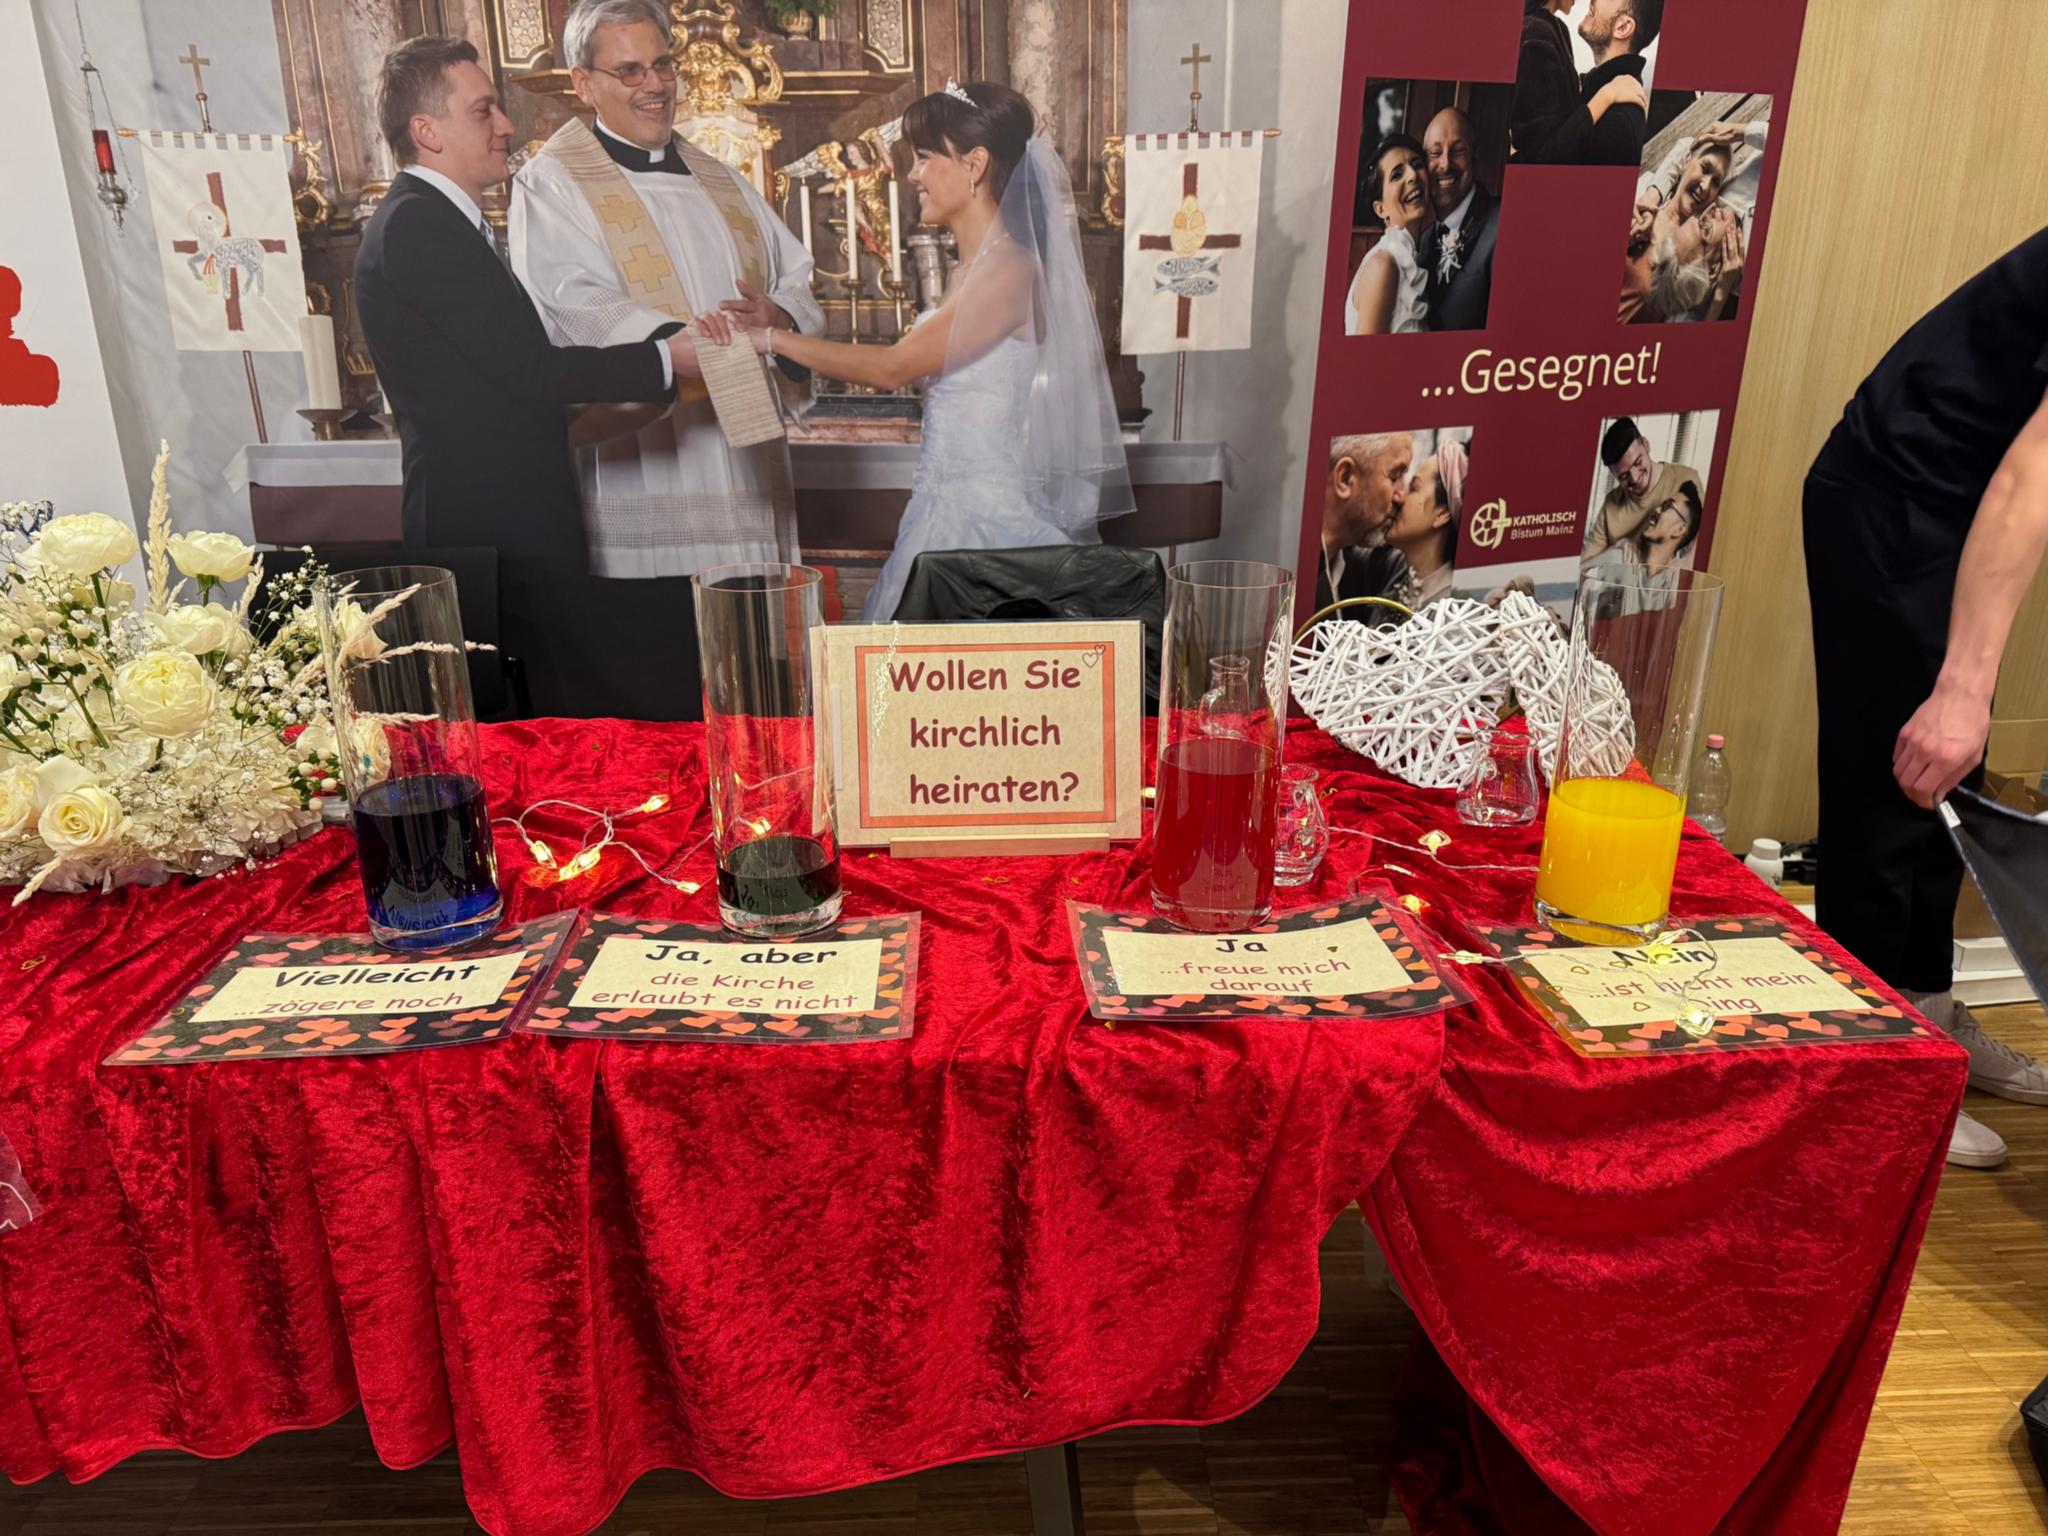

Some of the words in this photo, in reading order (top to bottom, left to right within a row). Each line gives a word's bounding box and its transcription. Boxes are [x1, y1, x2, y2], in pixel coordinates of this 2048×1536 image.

[1421, 341, 1662, 401] ...Gesegnet!
[1513, 511, 1577, 527] KATHOLISCH
[1511, 527, 1543, 540] Bistum
[1545, 525, 1575, 536] Mainz
[888, 658, 1008, 693] Wollen
[1024, 658, 1081, 690] Sie
[910, 714, 1061, 748] kirchlich
[910, 771, 1079, 805] heiraten?
[645, 944, 713, 965] Ja,
[740, 947, 838, 964] aber
[1215, 938, 1269, 953] Ja
[275, 963, 480, 989] Vielleicht
[1160, 961, 1266, 975] ...freue
[1278, 958, 1351, 975] mich
[650, 971, 699, 987] die
[712, 973, 815, 990] Kirche
[1209, 978, 1315, 993] darauf
[1589, 980, 1645, 998] ...ist
[1655, 974, 1731, 993] nicht
[1740, 971, 1815, 988] mein
[234, 999, 375, 1016] ...zögere
[385, 992, 462, 1009] noch
[591, 989, 716, 1006] erlaubt
[727, 994, 763, 1008] es
[774, 993, 859, 1010] nicht
